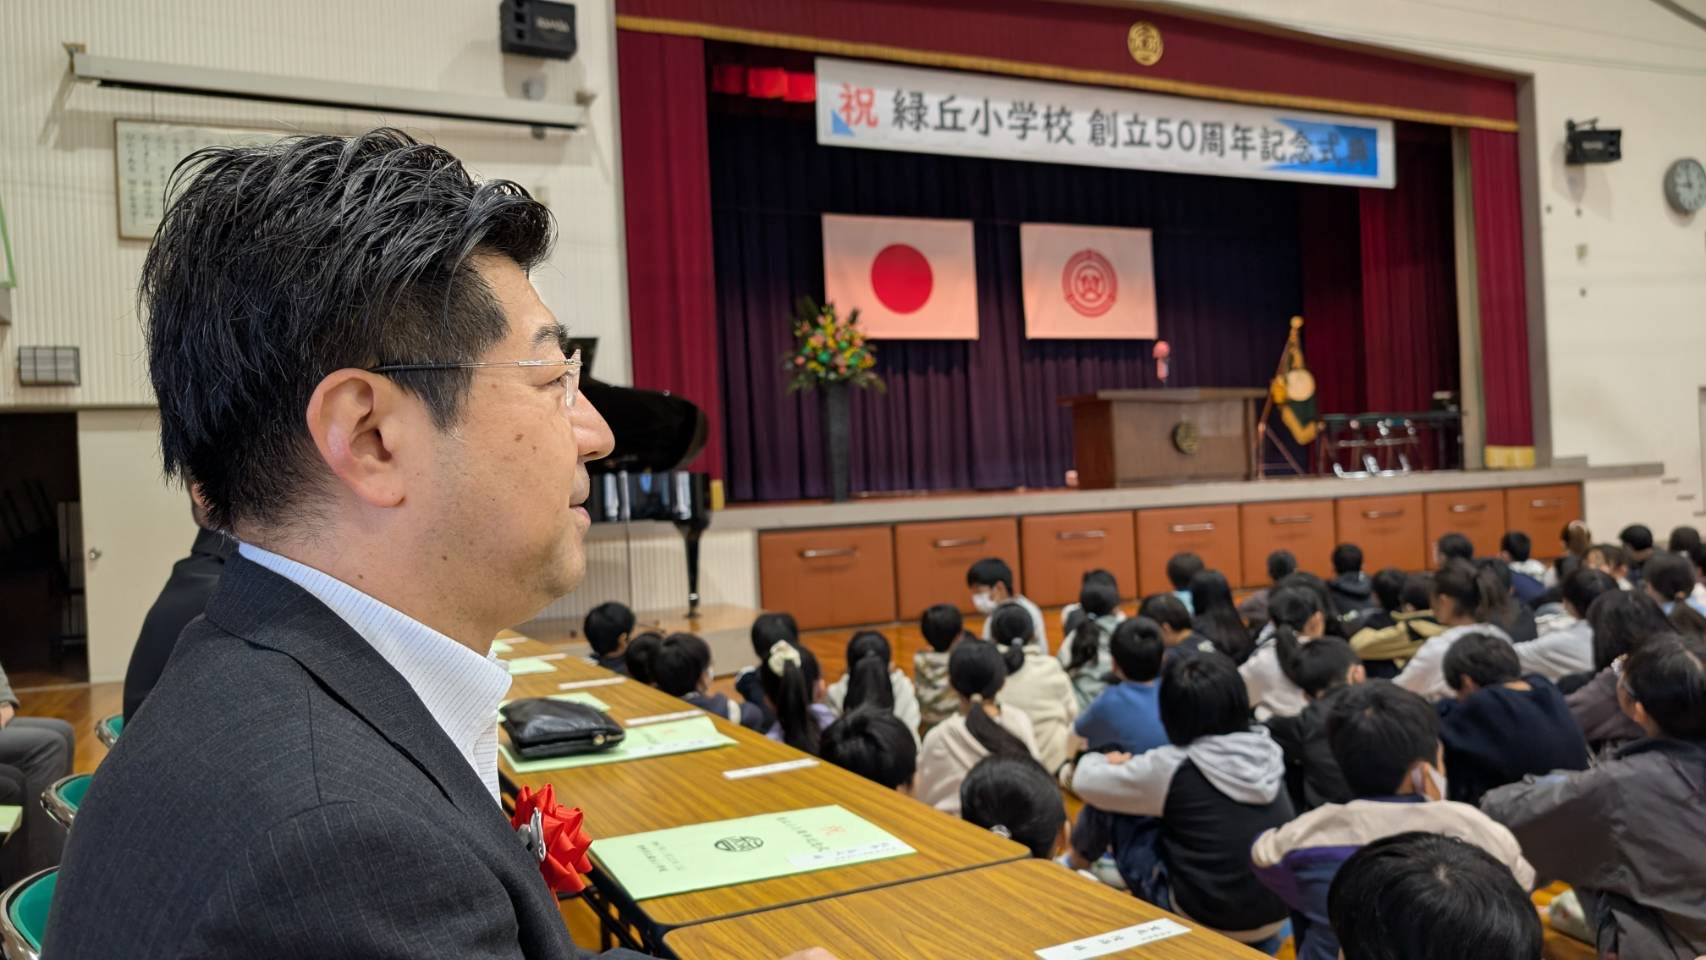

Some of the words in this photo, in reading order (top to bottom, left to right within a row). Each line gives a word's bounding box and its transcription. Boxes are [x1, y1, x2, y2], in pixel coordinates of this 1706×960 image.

[838, 82, 879, 129] 祝
[892, 89, 1076, 146] 緑丘小学校
